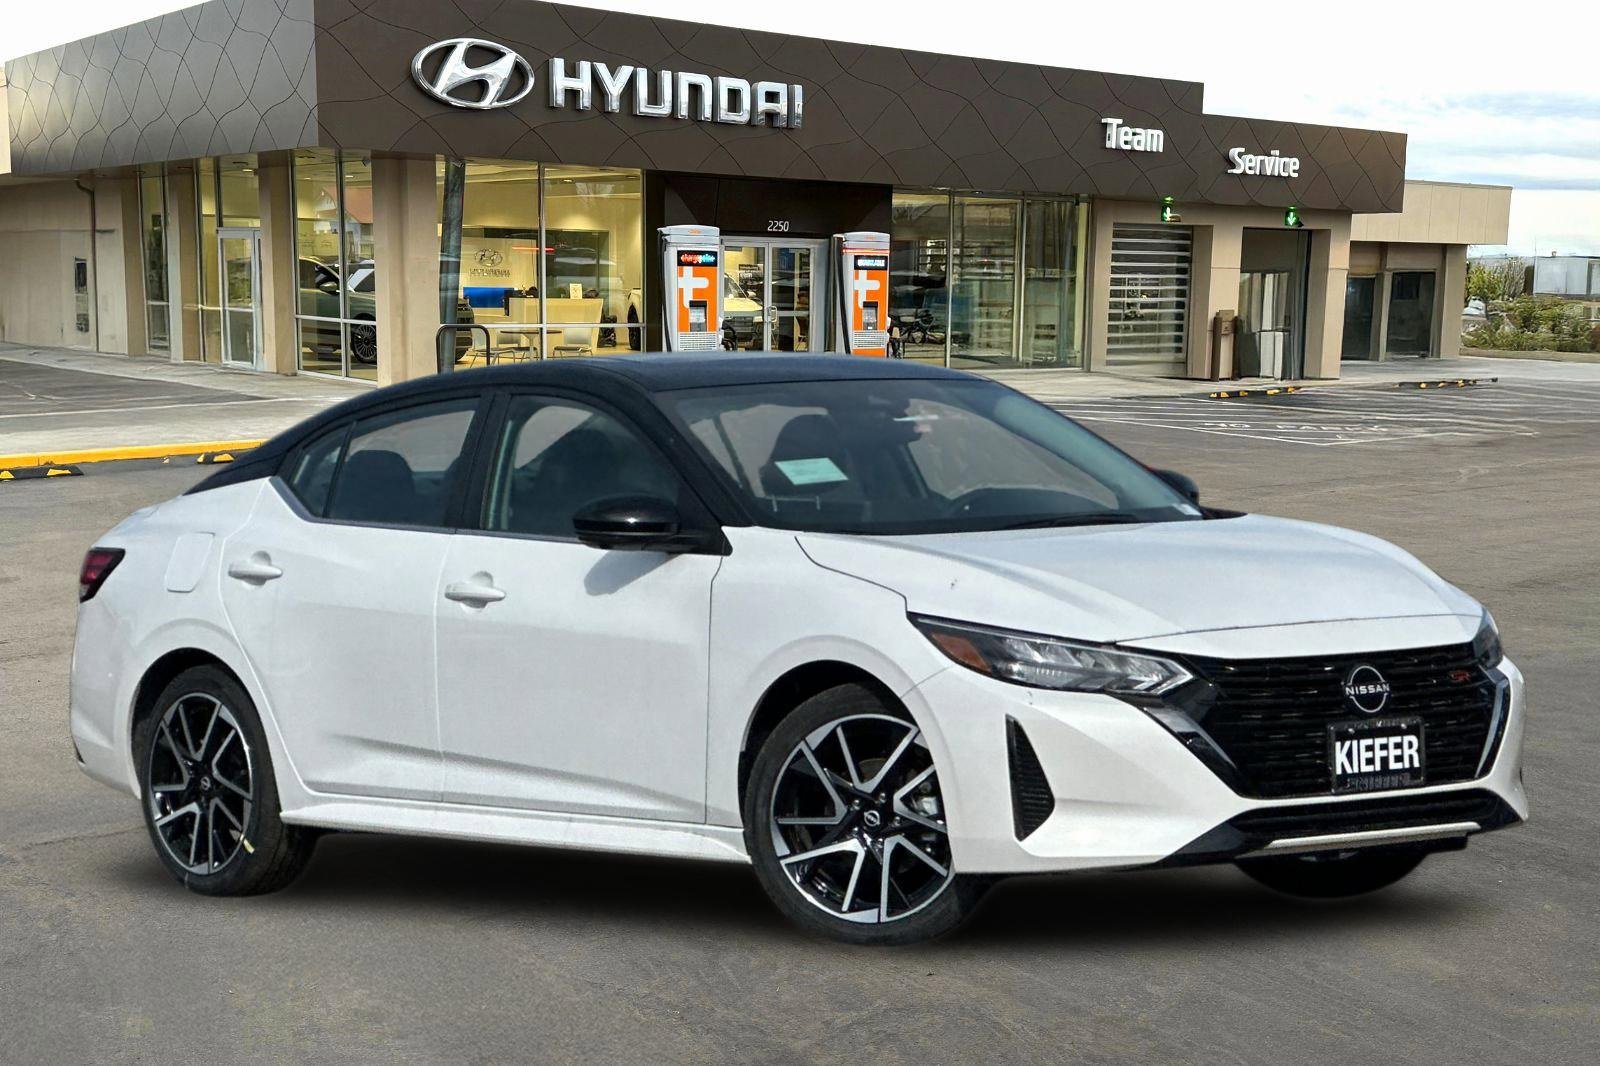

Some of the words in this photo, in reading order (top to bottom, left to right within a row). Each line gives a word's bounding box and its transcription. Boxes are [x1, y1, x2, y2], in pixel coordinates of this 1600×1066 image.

[549, 57, 804, 129] HYUNDAI
[1101, 117, 1164, 153] Team
[1227, 147, 1300, 178] Service
[767, 220, 790, 232] 2250
[1345, 683, 1390, 696] NISSAN
[1335, 734, 1420, 775] KIEFER
